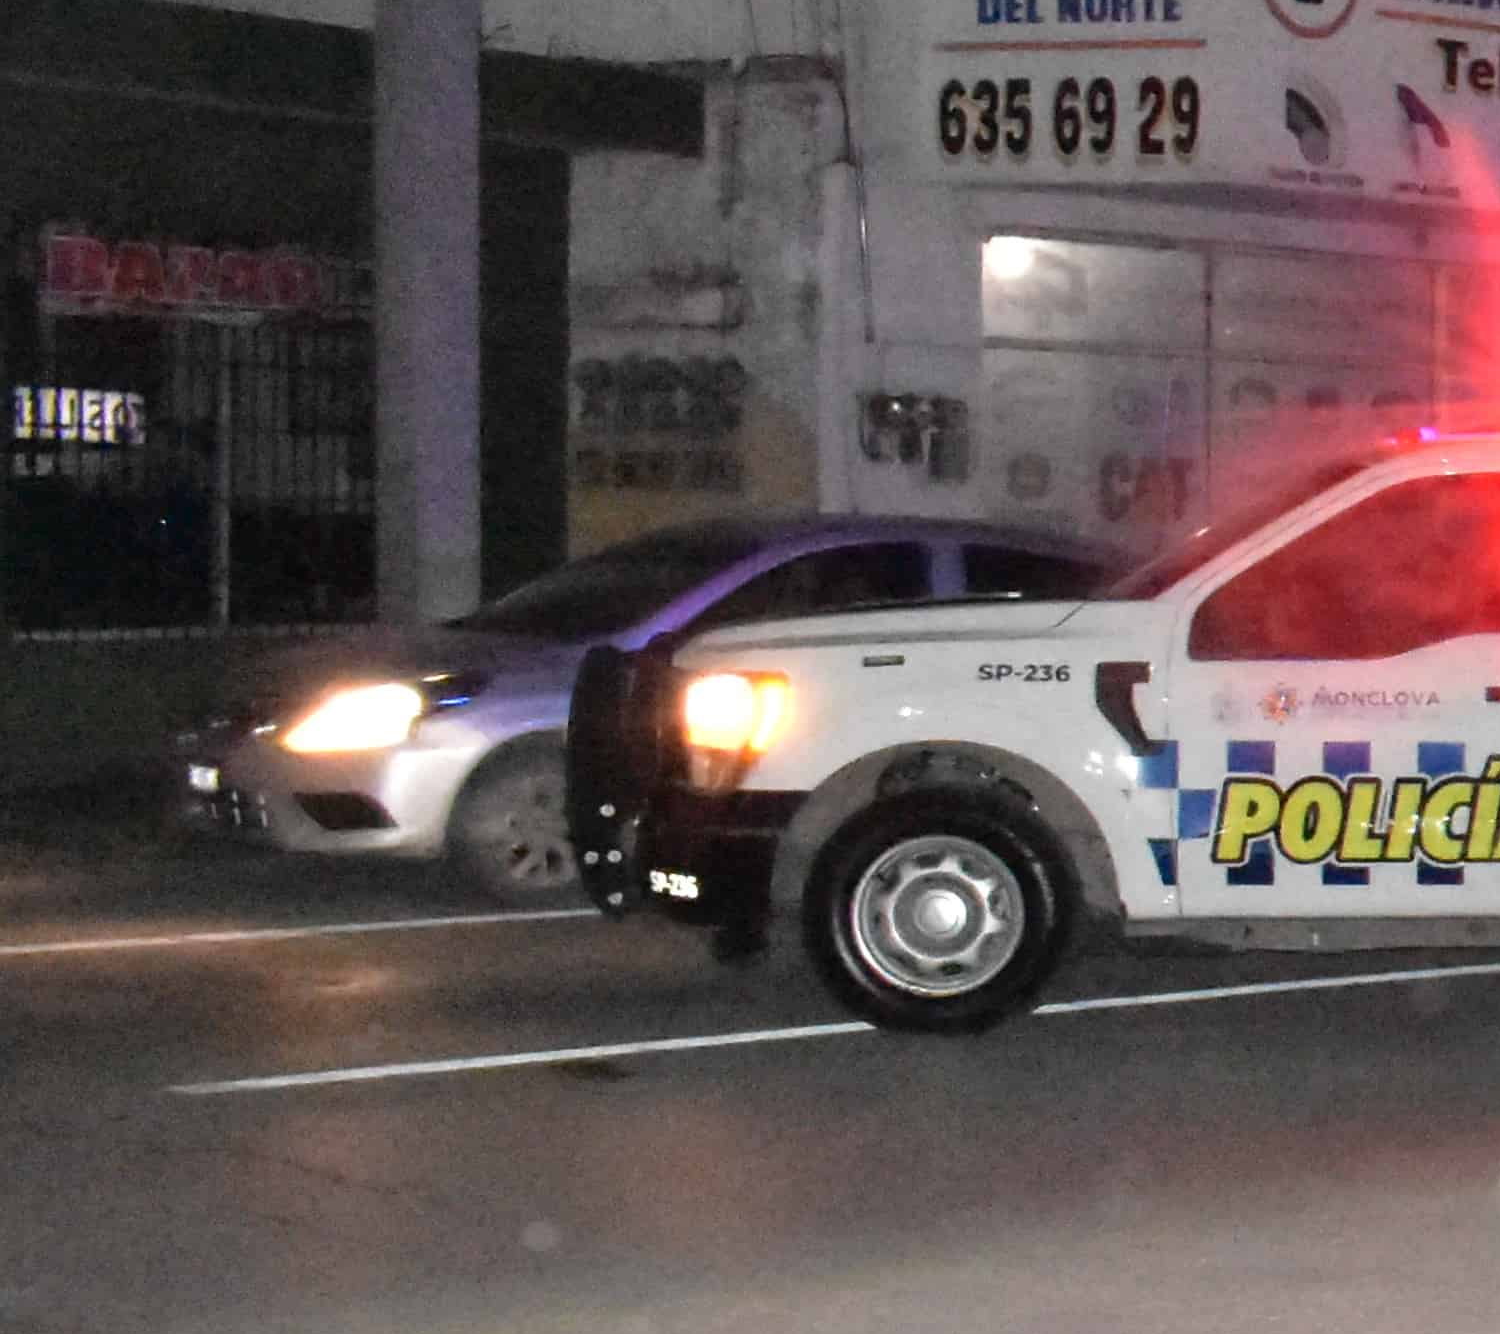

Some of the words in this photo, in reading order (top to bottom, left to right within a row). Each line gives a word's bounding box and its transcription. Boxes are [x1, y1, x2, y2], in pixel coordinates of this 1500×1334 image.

[938, 76, 1032, 156] 635
[1053, 76, 1117, 156] 69
[1136, 75, 1201, 156] 29
[977, 663, 1072, 683] SP-236
